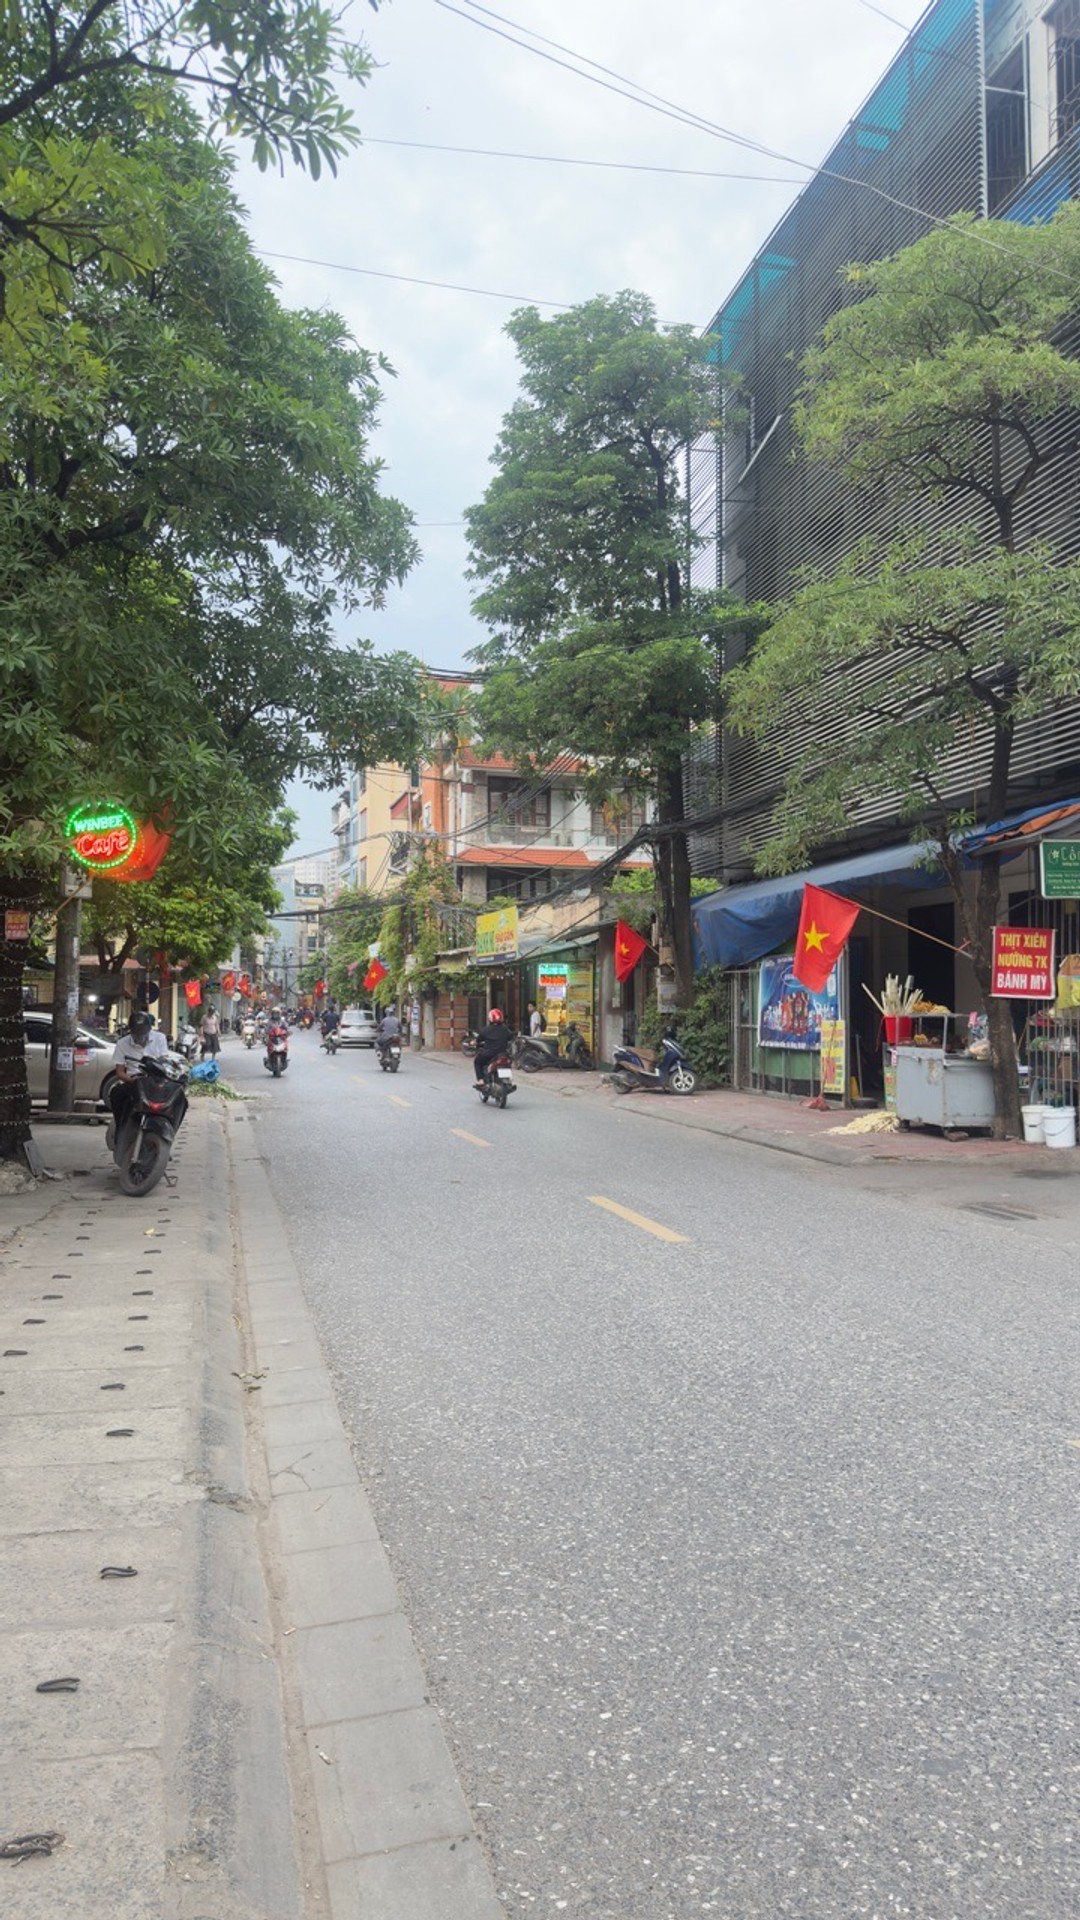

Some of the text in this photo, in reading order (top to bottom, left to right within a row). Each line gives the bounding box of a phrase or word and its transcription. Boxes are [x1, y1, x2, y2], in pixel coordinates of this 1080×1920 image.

[74, 815, 124, 832] WINBEE
[1000, 932, 1047, 950] THỊT XIÊN
[1035, 956, 1048, 968] 7K
[997, 971, 1027, 989] BÁNH
